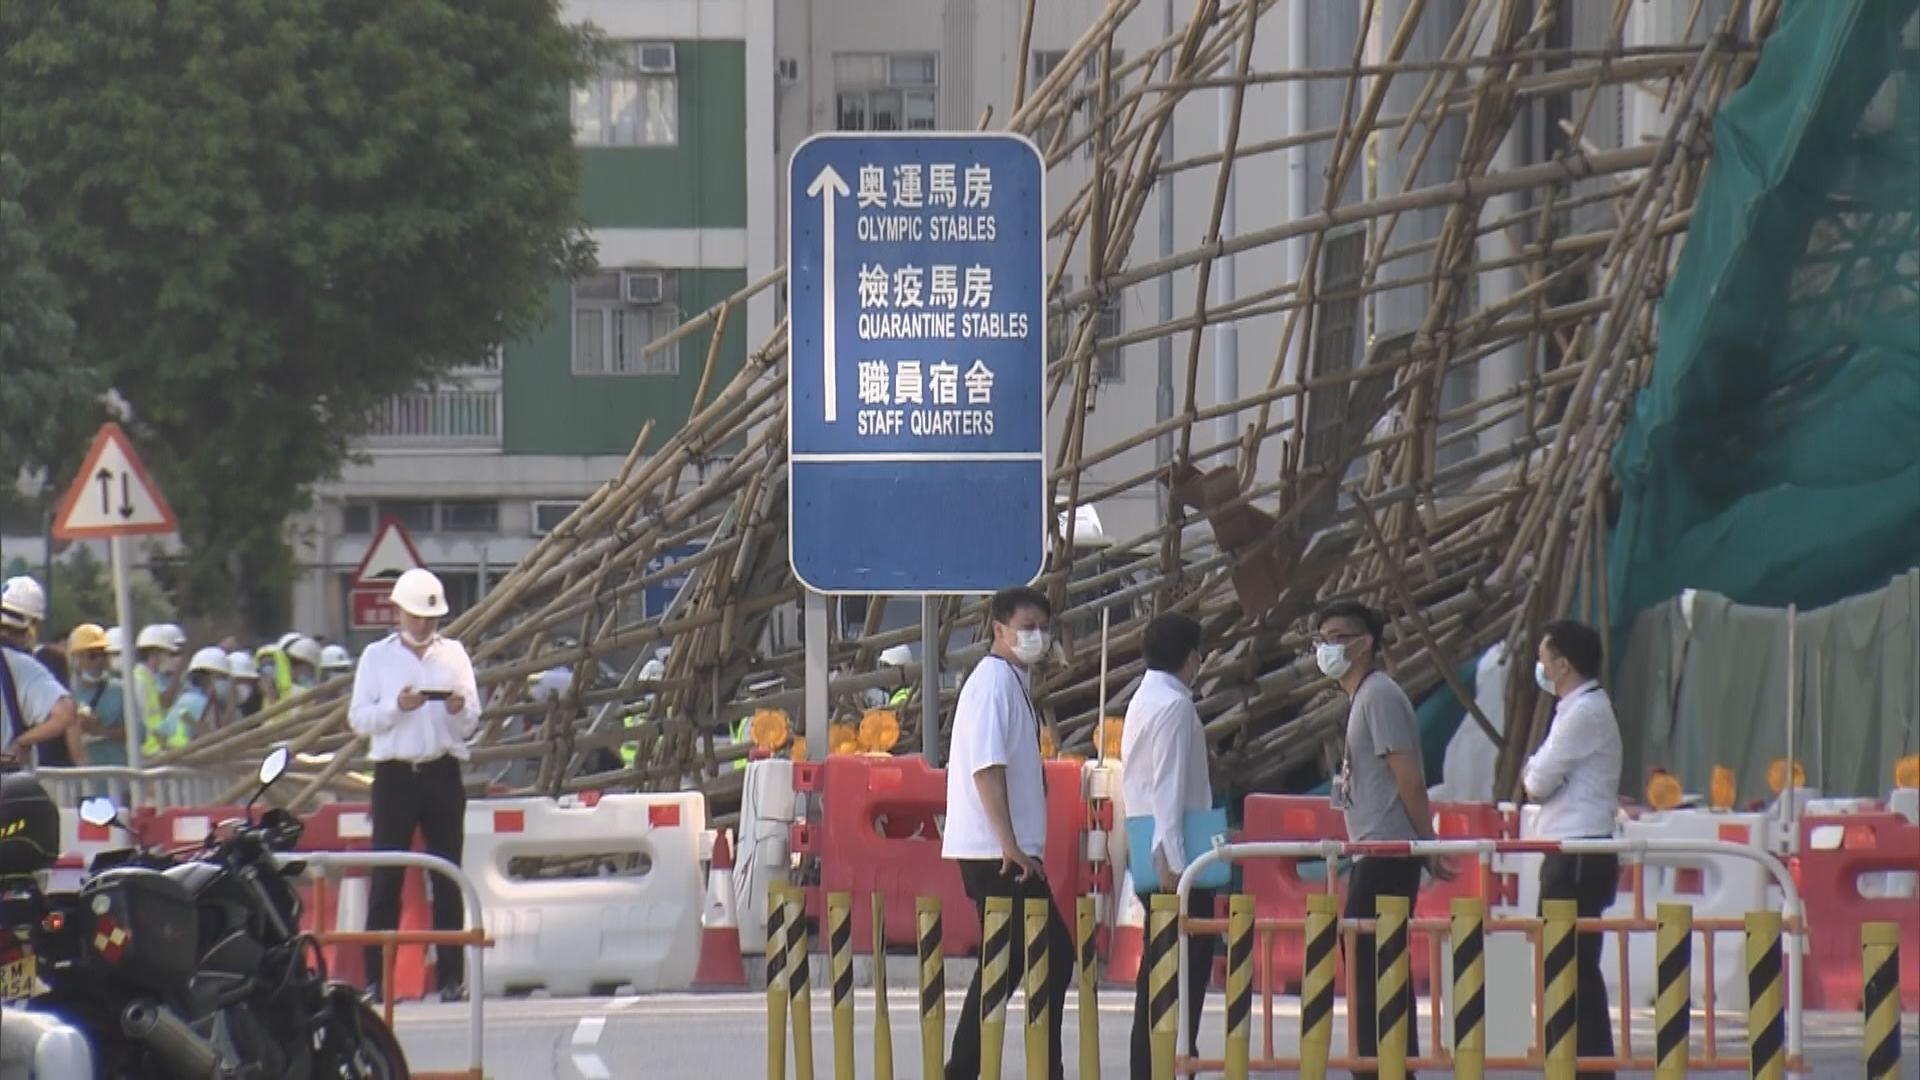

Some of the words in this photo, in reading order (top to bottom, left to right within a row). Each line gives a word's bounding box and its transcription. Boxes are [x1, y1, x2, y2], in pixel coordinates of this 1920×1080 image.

[857, 215, 923, 241] OLYMPIC
[929, 215, 996, 241] STABLES
[858, 263, 993, 309] 檢疫馬房
[858, 312, 956, 340] QUARANTINE
[961, 312, 1028, 338] STABLES
[857, 359, 994, 406] 職員宿舍
[857, 410, 904, 436] STAFF
[910, 410, 994, 436] QUARTERS
